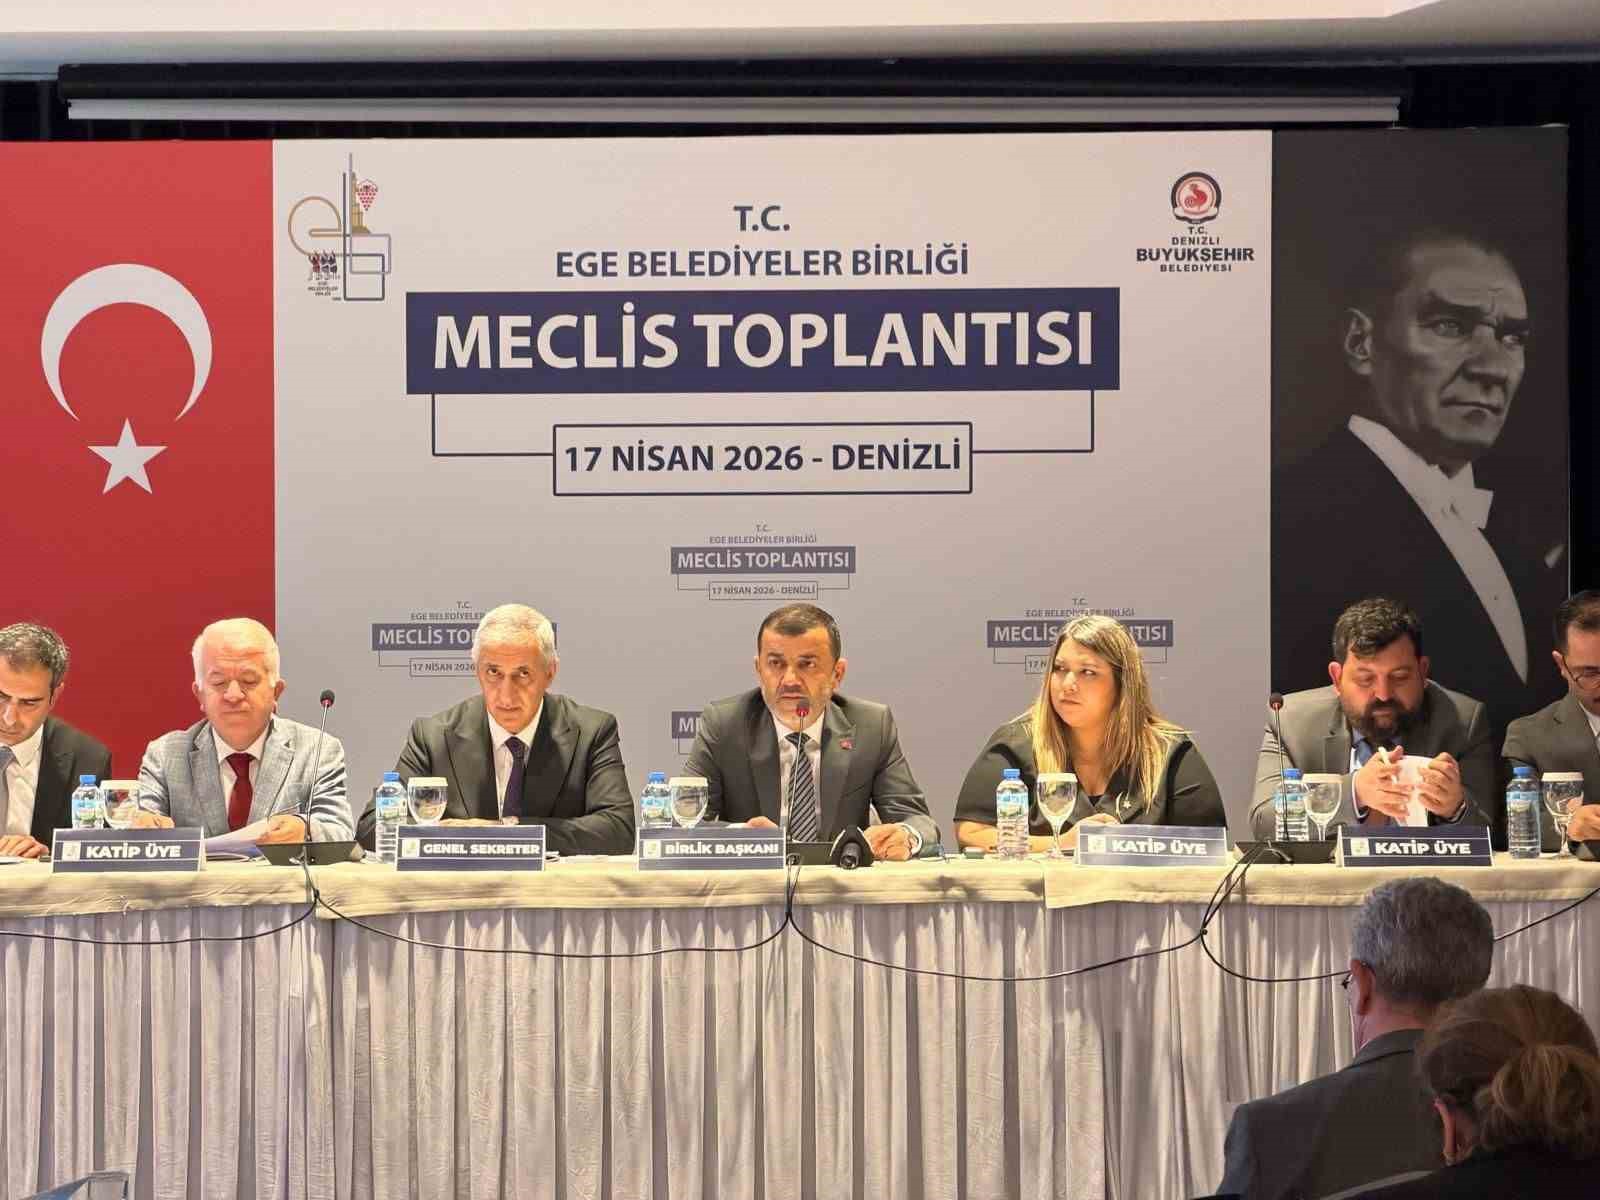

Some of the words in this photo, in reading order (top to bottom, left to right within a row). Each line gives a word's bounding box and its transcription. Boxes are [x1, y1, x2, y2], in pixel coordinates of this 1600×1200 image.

[733, 205, 790, 231] T.C.
[1187, 226, 1208, 235] T.C.
[556, 251, 618, 277] EGE
[628, 244, 843, 277] BELEDİYELER
[852, 243, 968, 276] BİRLİĞİ
[433, 302, 678, 370] MECLİS
[693, 311, 1093, 369] TOPLANTISI
[565, 446, 602, 472] 17
[612, 440, 714, 471] NİSAN
[724, 445, 803, 471] 2026
[832, 438, 960, 470] DENİZLİ
[678, 549, 741, 568] MECLİS
[745, 551, 849, 568] TOPLANTISI
[379, 625, 443, 645] MECLİS
[994, 622, 1058, 642] MECLİS
[86, 842, 140, 858] KATİP
[145, 842, 182, 858] ÜYE
[423, 843, 467, 855] GENEL
[470, 843, 540, 855] SEKRETER
[665, 841, 712, 855] BİRLİK
[715, 843, 779, 857] BAŞKANI
[1111, 837, 1166, 854] KATİP
[1170, 839, 1207, 855] ÜYE
[1375, 839, 1429, 855] KATİP
[1434, 840, 1472, 855] ÜYE
